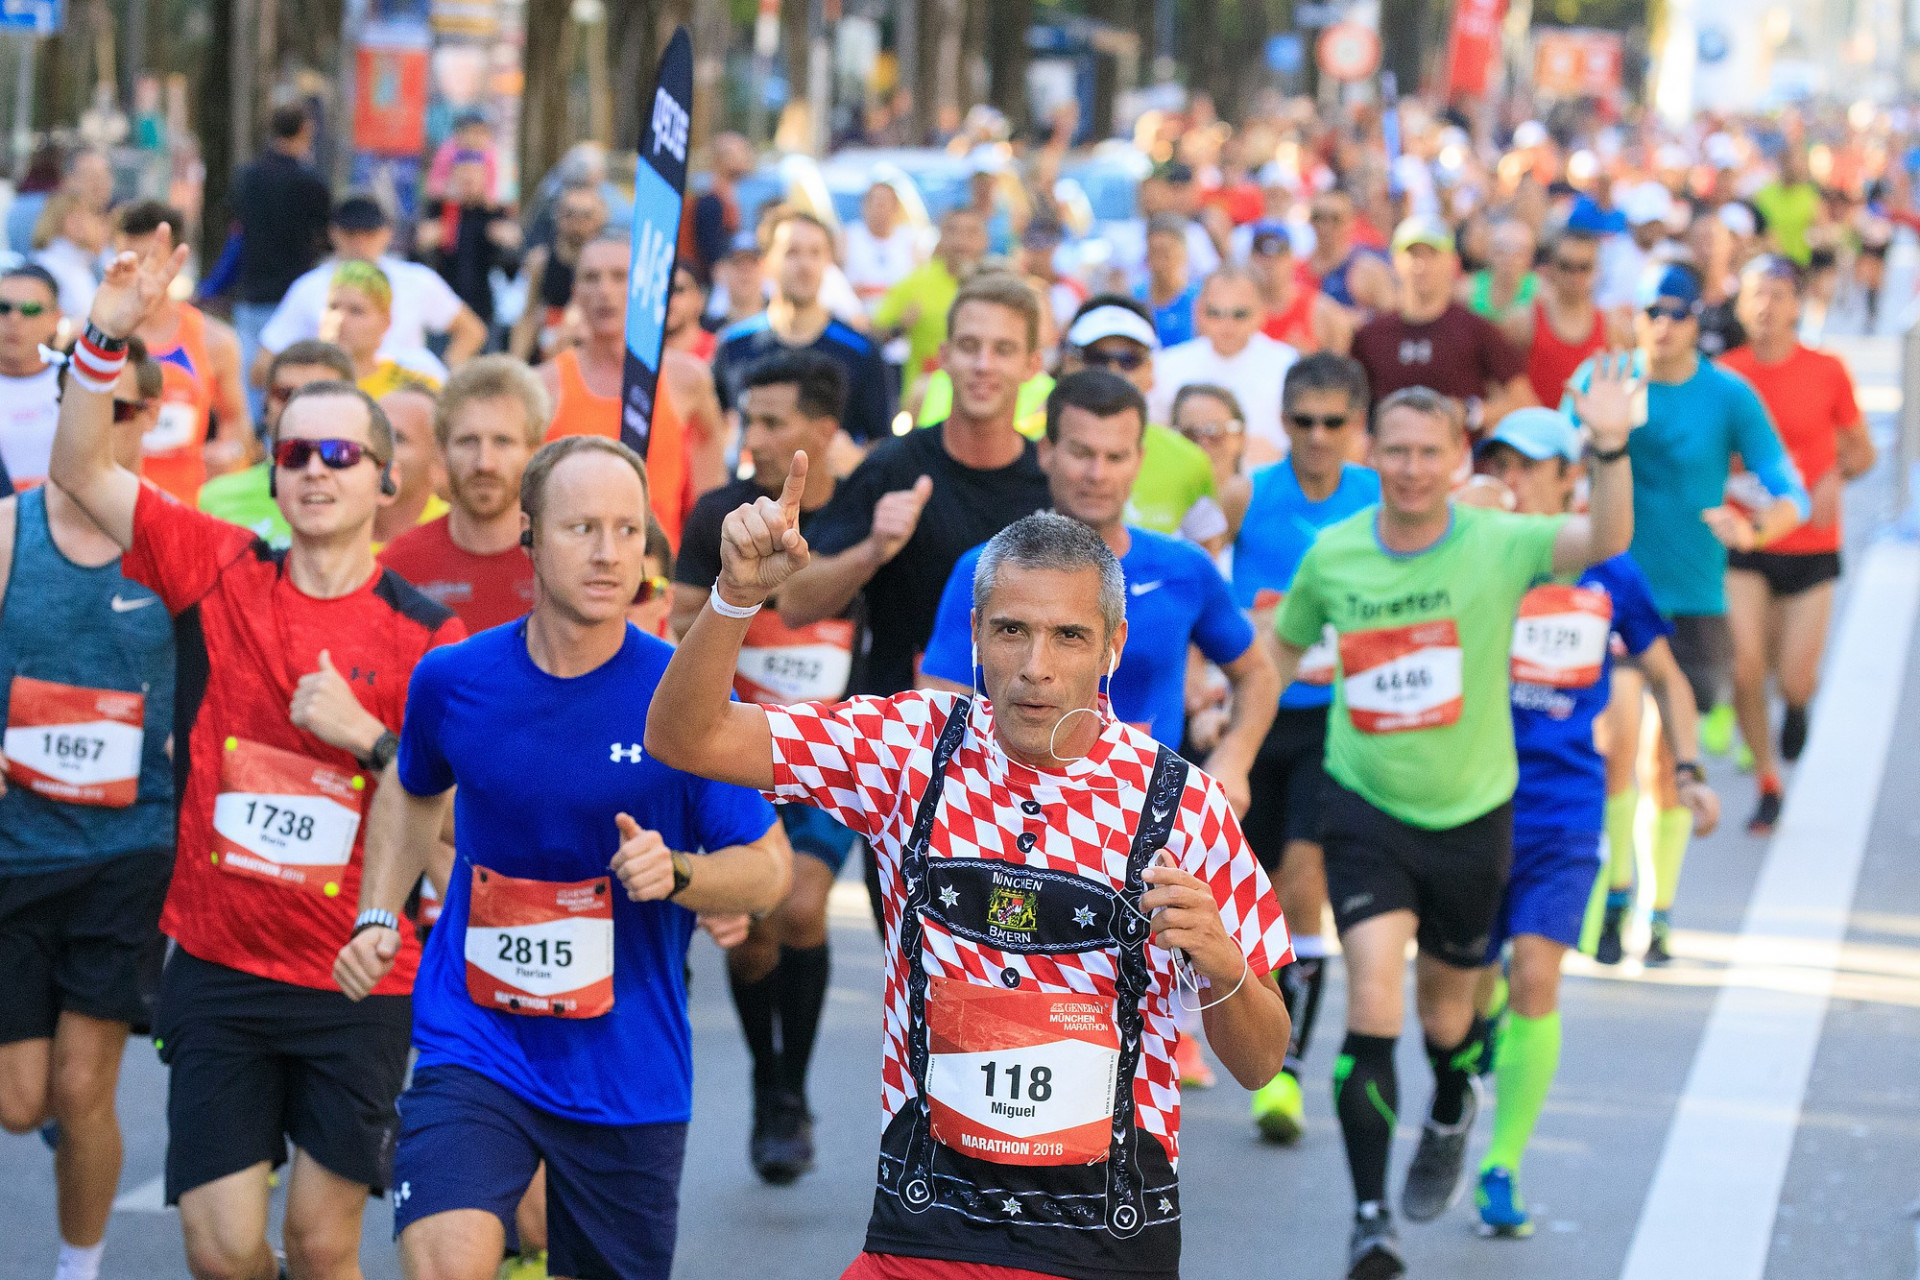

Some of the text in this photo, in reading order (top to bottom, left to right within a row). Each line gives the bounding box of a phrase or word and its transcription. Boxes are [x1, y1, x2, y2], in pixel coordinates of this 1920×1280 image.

[44, 732, 104, 762] 1667
[246, 800, 315, 841] 1738
[498, 933, 573, 967] 2815
[1049, 1012, 1095, 1023] MÜNCHEN
[1063, 1023, 1109, 1032] MARATHON
[980, 1060, 1053, 1102] 118
[991, 1101, 1036, 1118] Miguel
[961, 1133, 1063, 1156] MARATHON 2018
